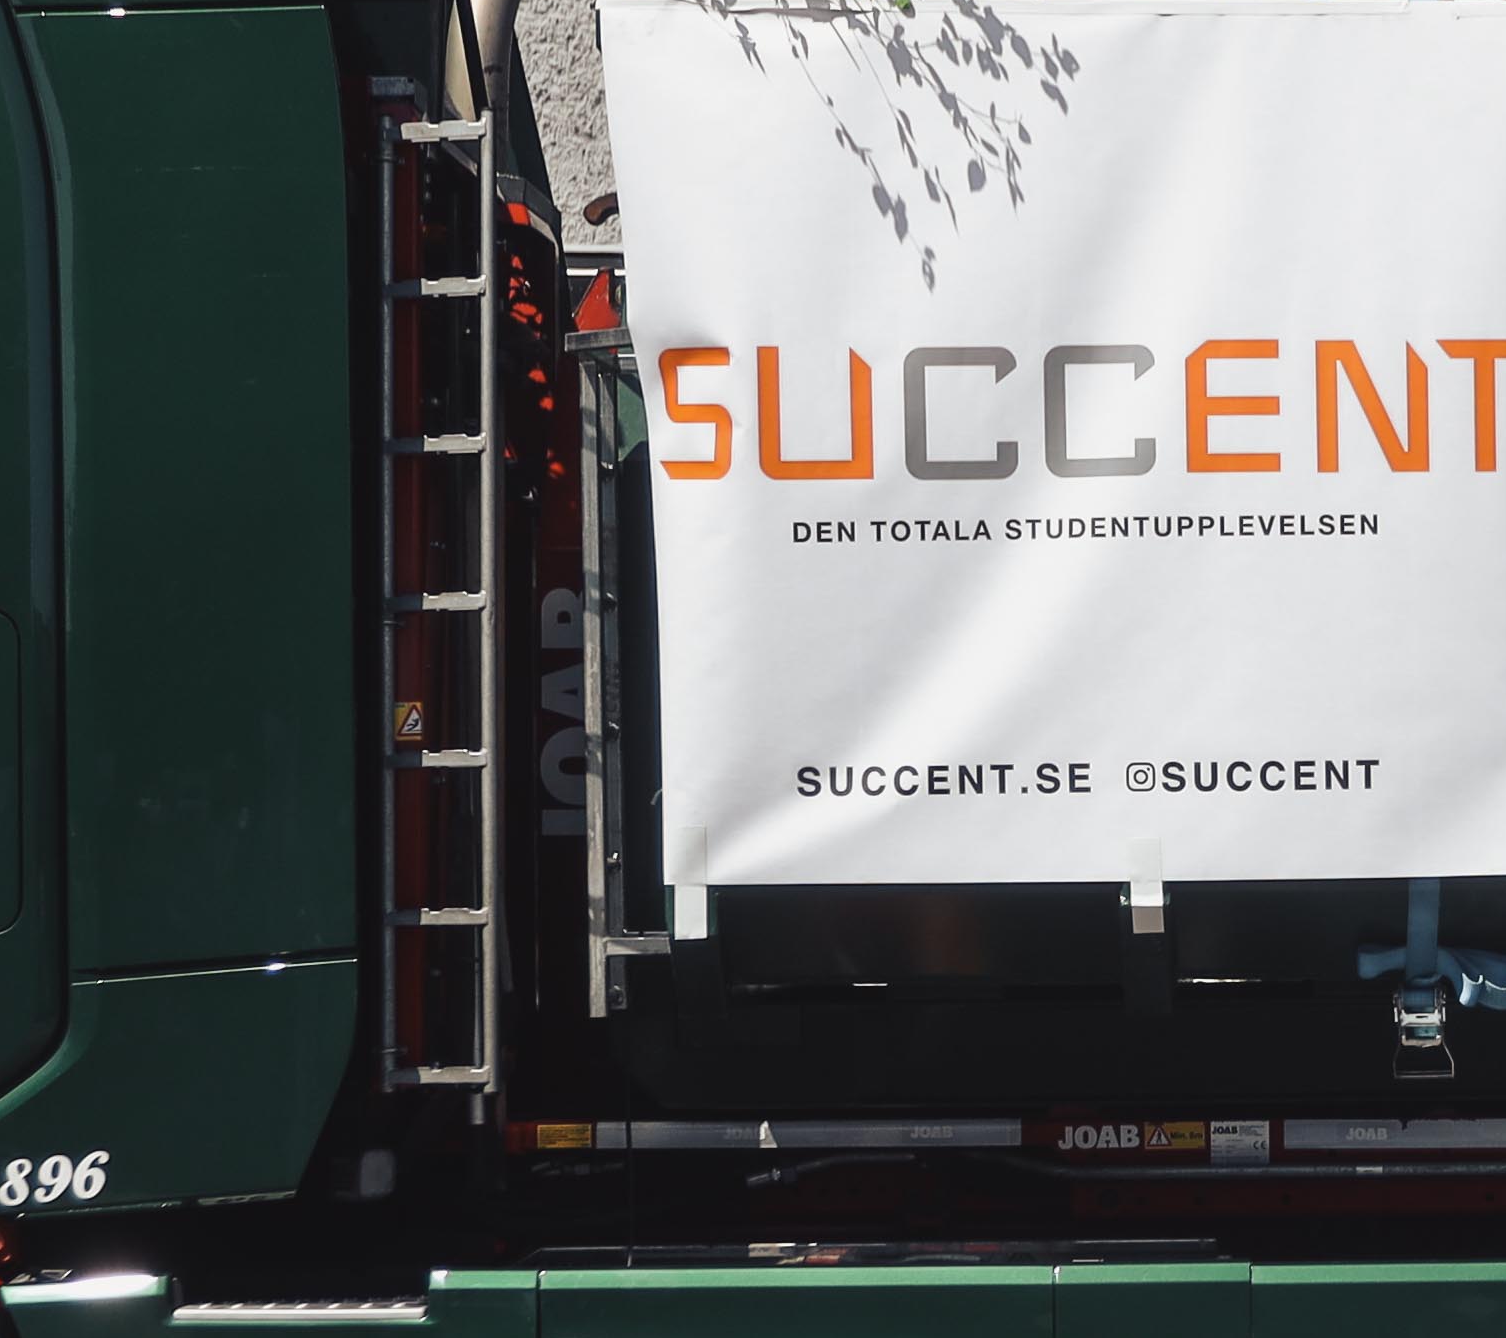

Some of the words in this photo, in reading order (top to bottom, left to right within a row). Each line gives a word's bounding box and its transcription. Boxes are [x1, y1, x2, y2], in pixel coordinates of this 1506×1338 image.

[792, 519, 857, 545] DEN
[869, 518, 992, 543] TOTALA
[1004, 513, 1382, 541] STUDENTUPPLEVELSEN
[795, 763, 1093, 798] SUCCENT.SE
[1057, 1124, 1141, 1150] JOAB
[1212, 1126, 1238, 1135] JOAB
[1346, 1127, 1388, 1141] JOAB
